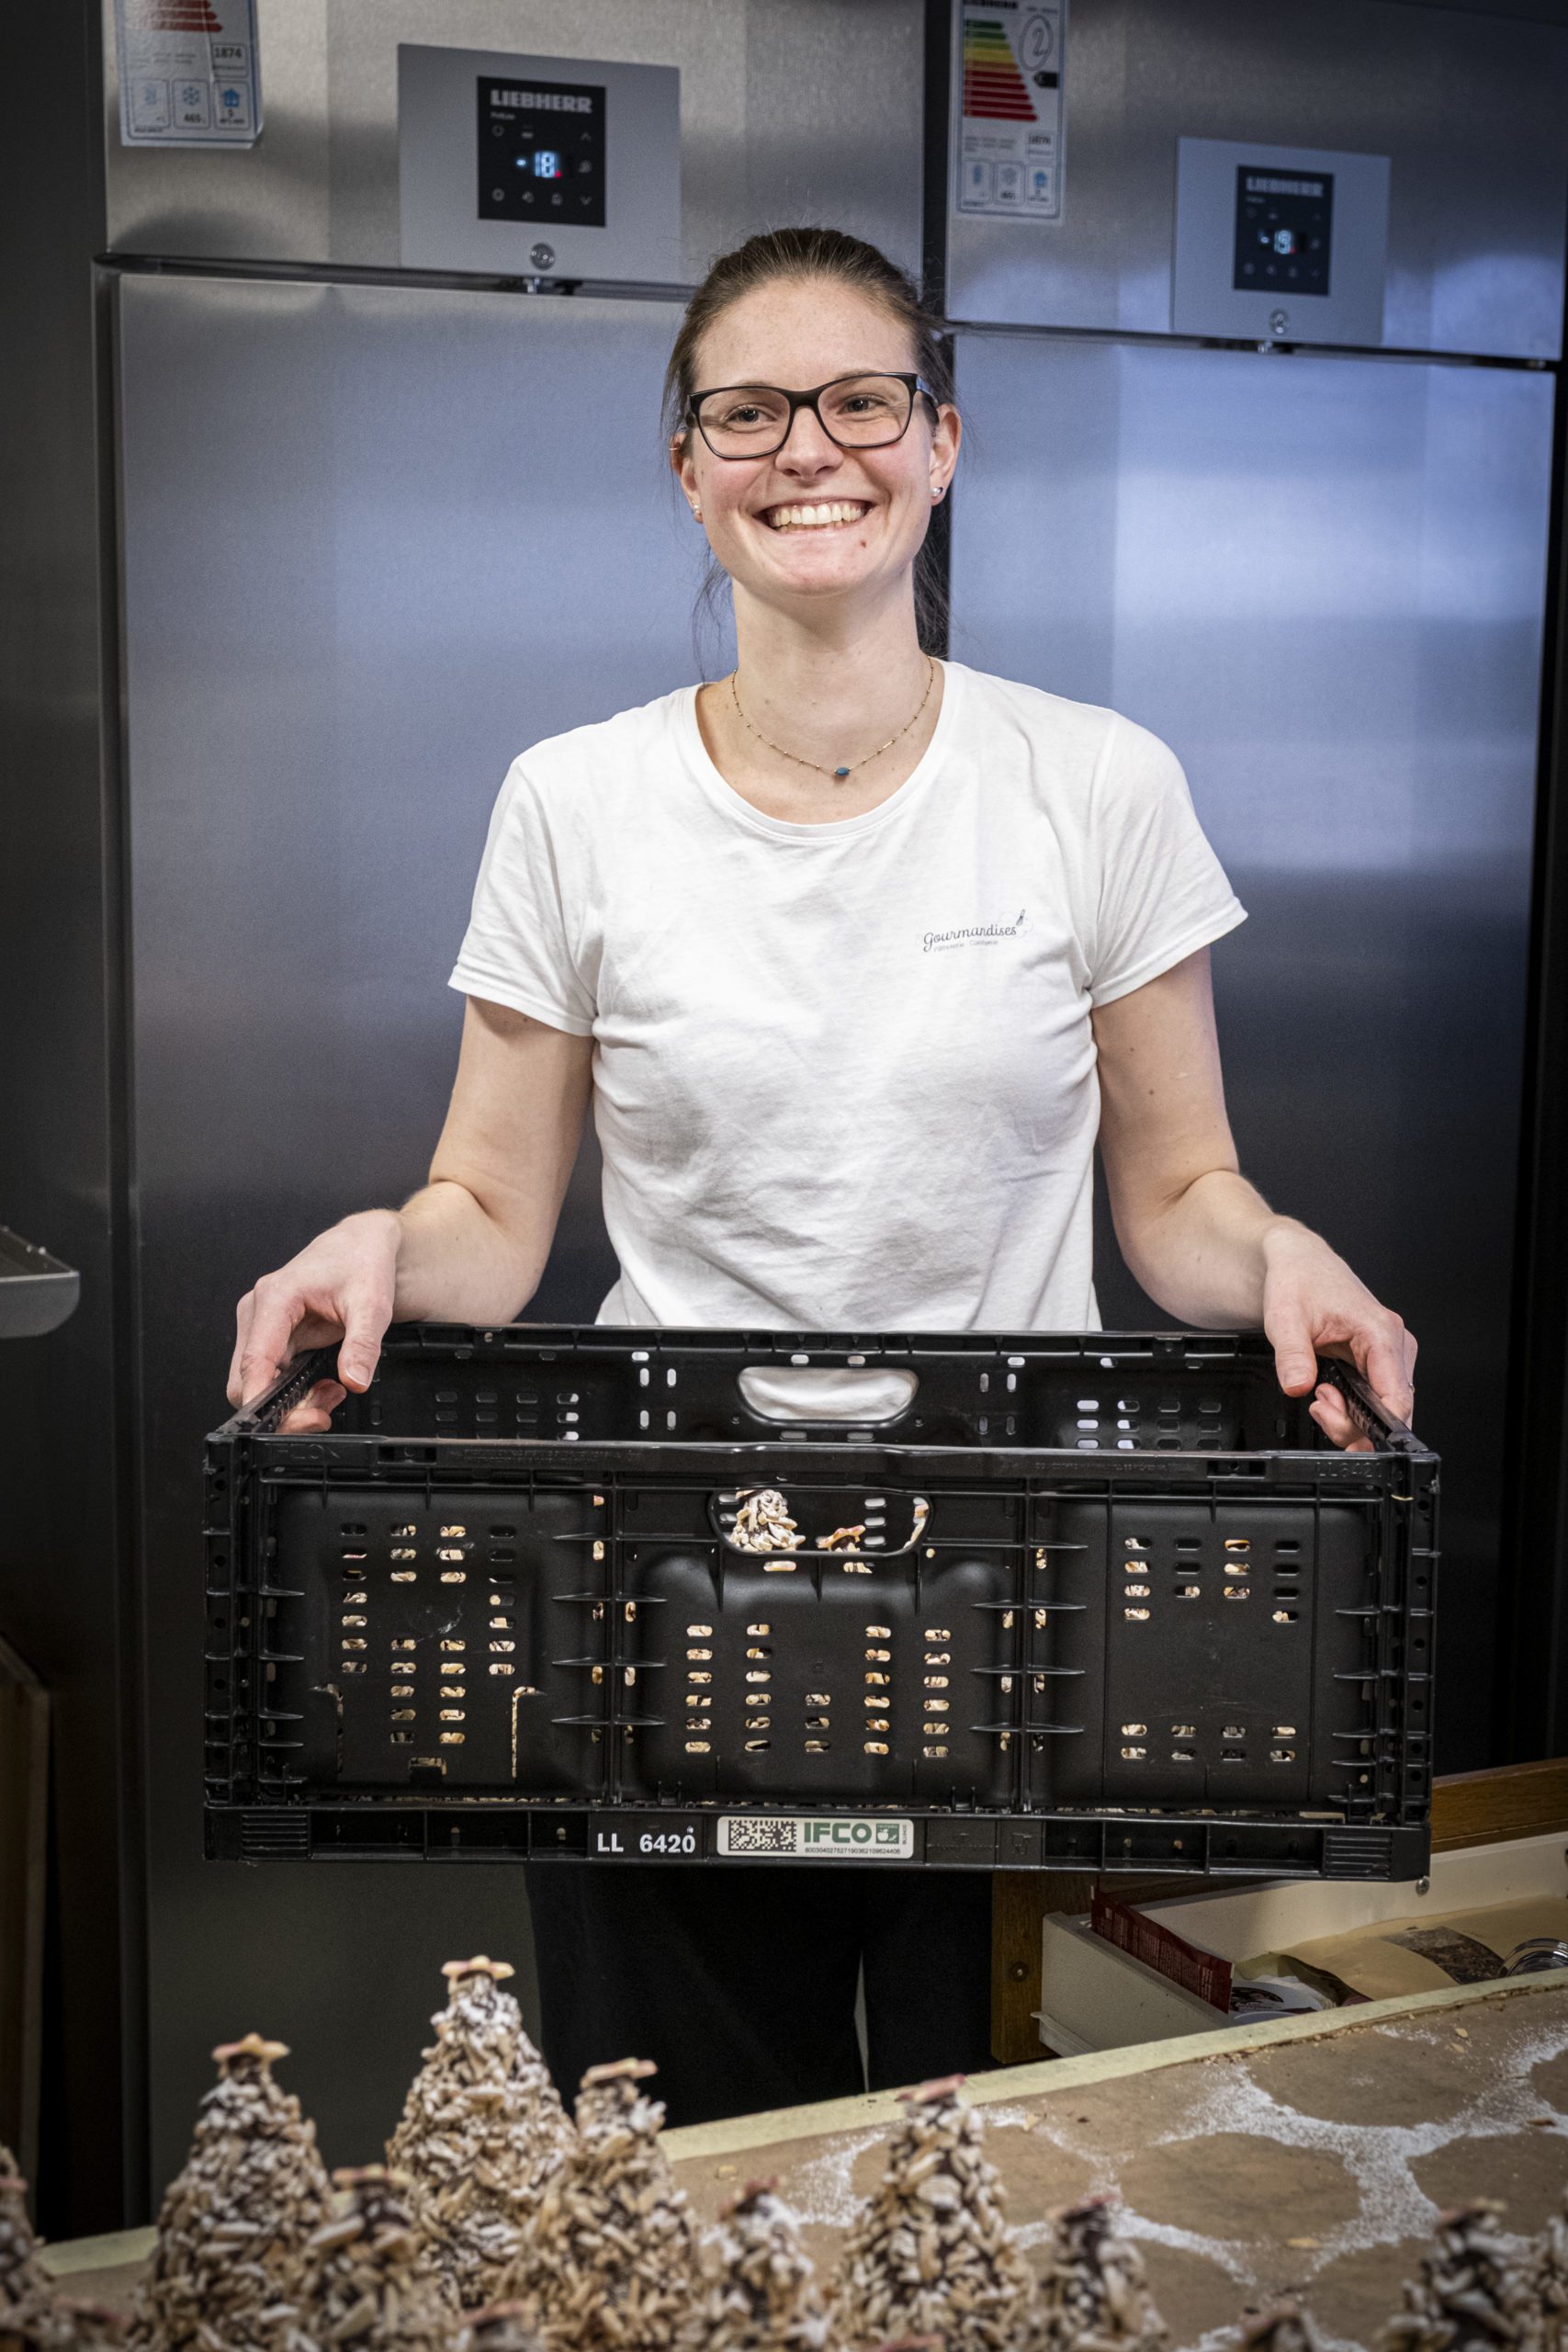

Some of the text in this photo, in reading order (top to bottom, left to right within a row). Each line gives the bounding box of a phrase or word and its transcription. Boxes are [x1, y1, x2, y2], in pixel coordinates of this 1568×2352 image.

[490, 88, 593, 114] LIEBHERR
[923, 923, 1017, 953] Gourmandises
[597, 1832, 695, 1853] LL 6420
[804, 1822, 872, 1844] IFCO
